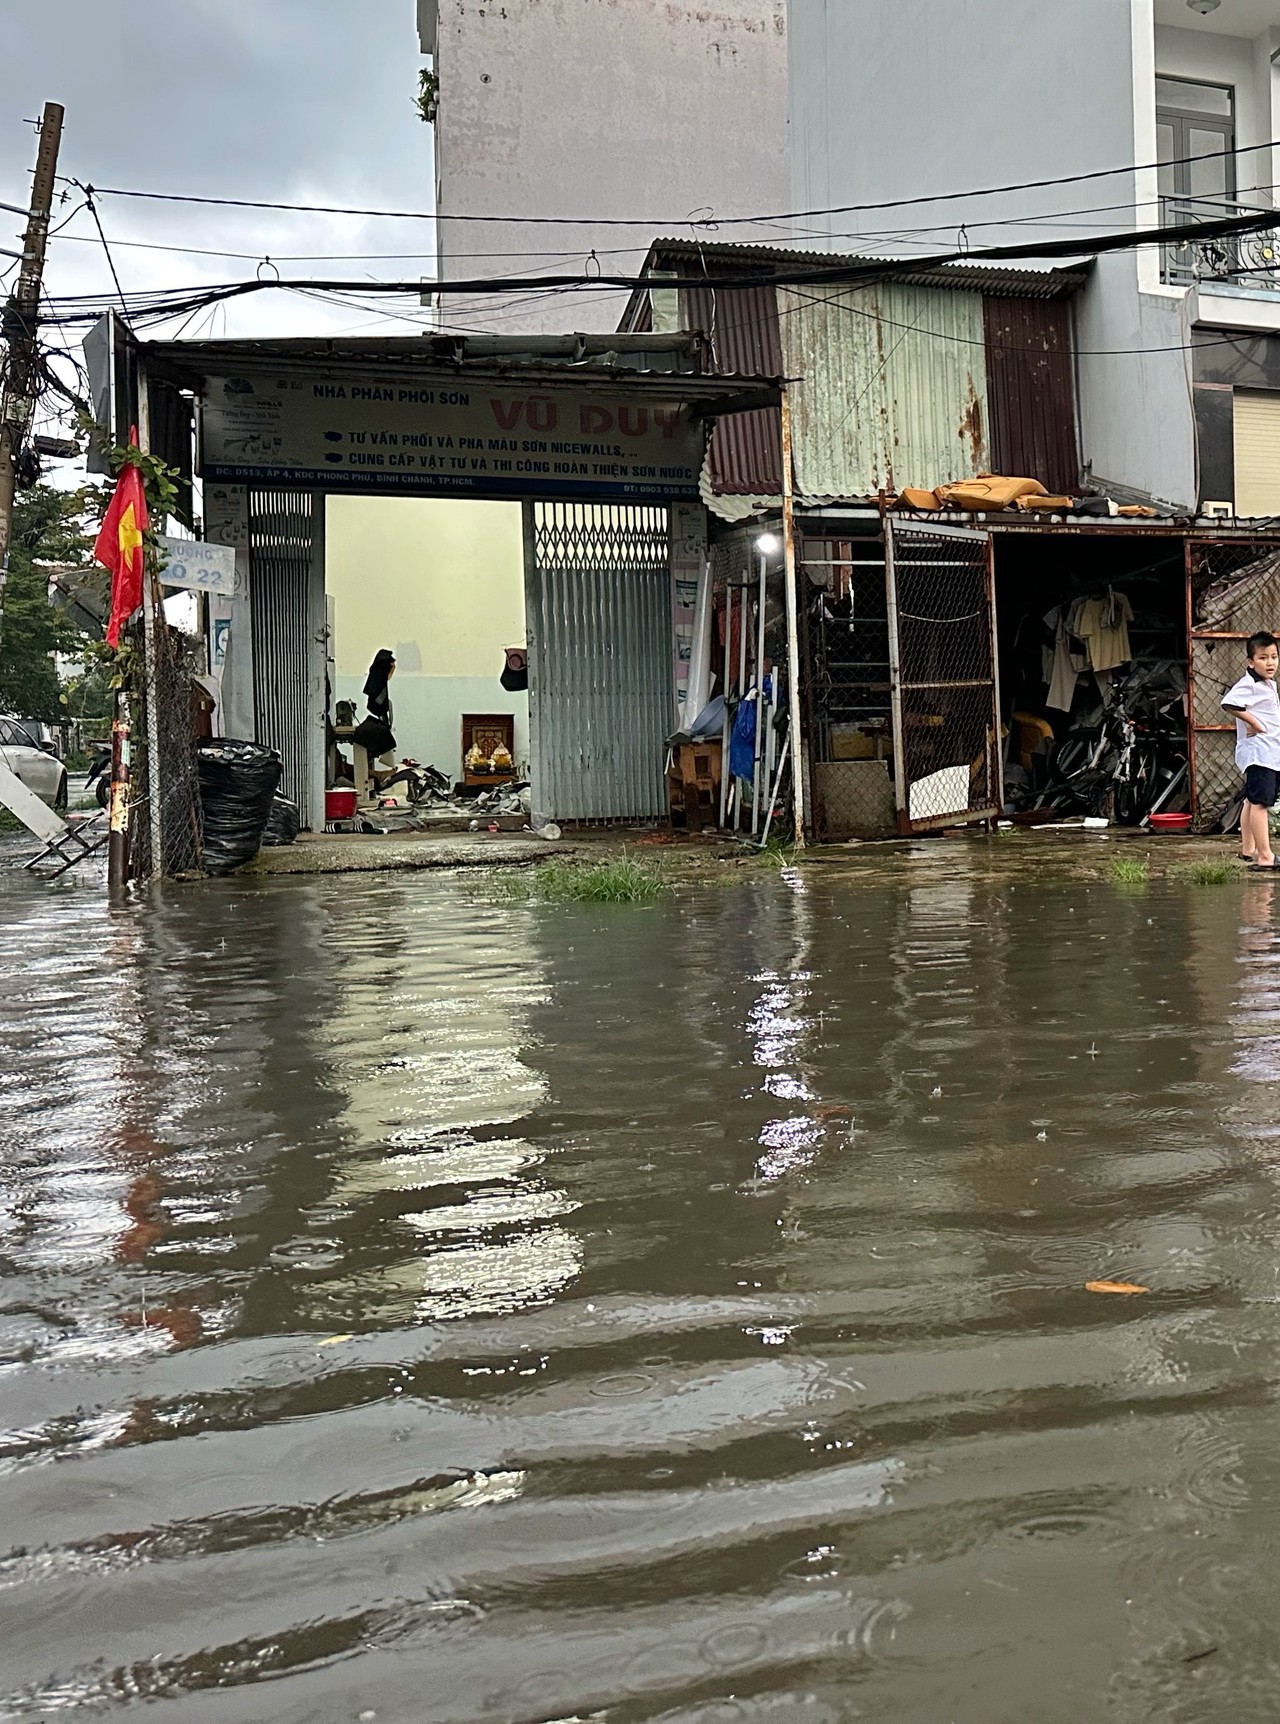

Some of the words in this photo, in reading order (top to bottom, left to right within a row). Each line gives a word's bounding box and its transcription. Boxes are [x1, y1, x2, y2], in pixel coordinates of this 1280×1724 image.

[439, 392, 469, 405] SƠN
[490, 395, 558, 432] VŨ
[580, 404, 681, 438] DUY
[348, 431, 366, 443] TƯ
[371, 430, 397, 445] VẤN
[402, 432, 432, 447] PHỐI
[437, 434, 453, 448] VÀ
[459, 438, 483, 449] PHA
[488, 437, 517, 451] MÀU
[523, 440, 546, 452] SƠN
[349, 453, 384, 465] CUNG
[389, 452, 414, 466] CẤP
[420, 455, 445, 470] VẬT
[450, 456, 467, 468] TƯ
[471, 457, 487, 469] VÀ
[493, 460, 512, 470] THI
[517, 459, 549, 472] CÔNG
[554, 460, 587, 473] HOÀN
[592, 463, 628, 478] THIỆN
[632, 465, 655, 477] SƠN
[660, 465, 692, 478] NƯỚC
[317, 472, 349, 481] PHONG
[198, 568, 222, 585] 22
